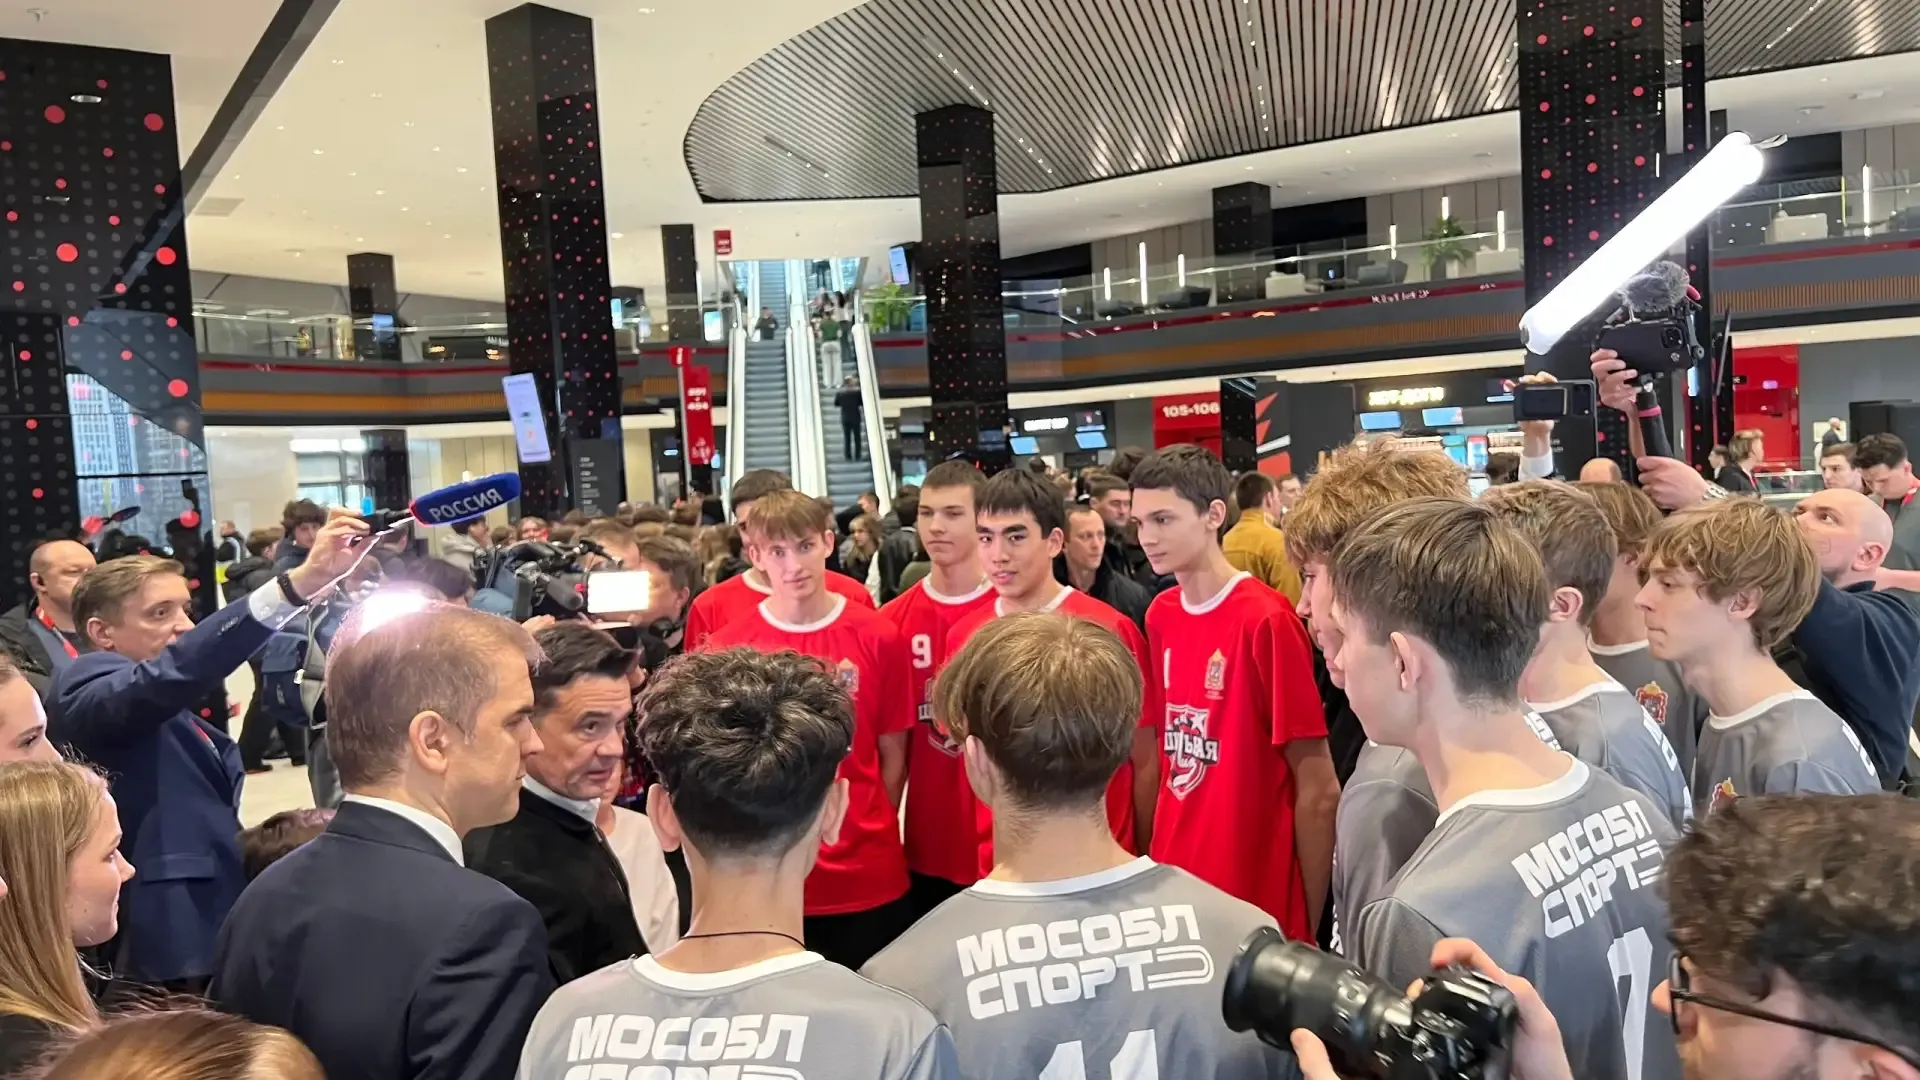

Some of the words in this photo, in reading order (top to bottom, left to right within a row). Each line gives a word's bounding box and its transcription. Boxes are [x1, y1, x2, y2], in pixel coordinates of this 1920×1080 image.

[428, 487, 503, 521] РОССИЯ
[911, 633, 932, 669] 9
[1511, 800, 1653, 899] МОСОБЛ
[1542, 847, 1640, 938] СПОРТ
[956, 904, 1201, 978] МОСОБЛ
[966, 950, 1153, 1020] СПОРТ
[567, 1014, 809, 1062] МОСОБЛ
